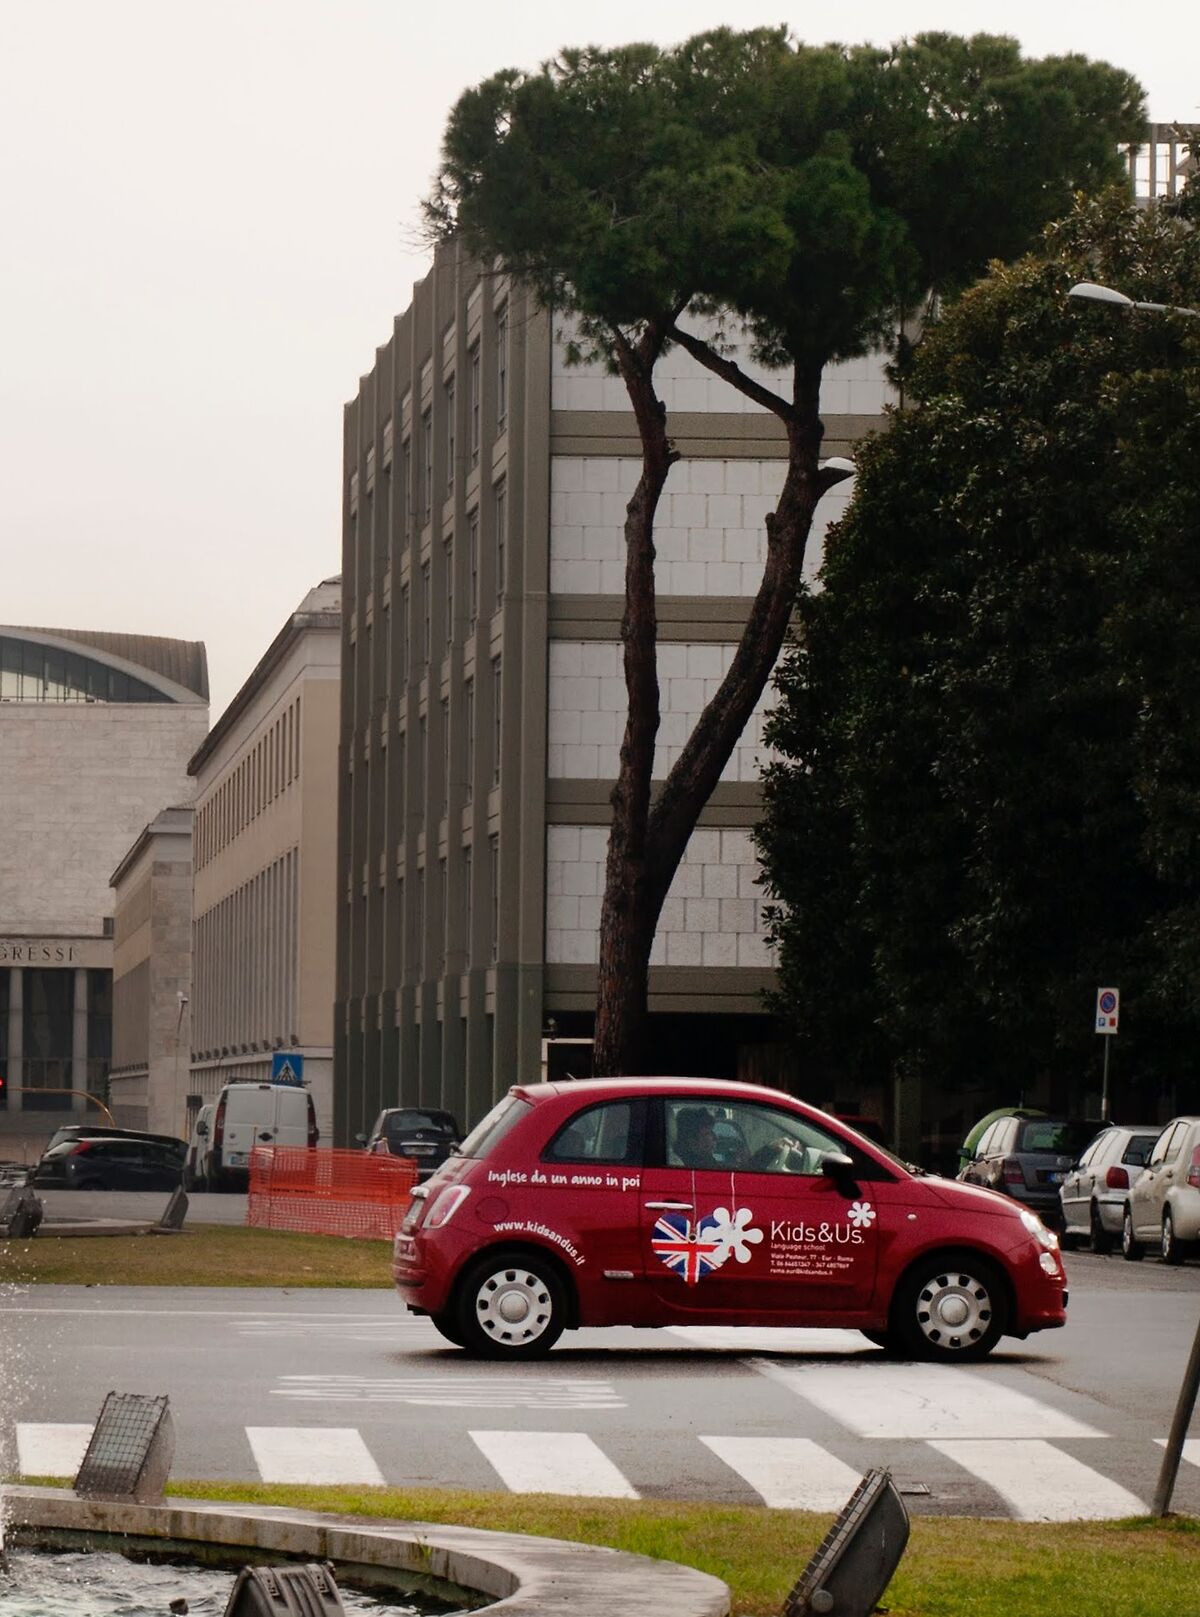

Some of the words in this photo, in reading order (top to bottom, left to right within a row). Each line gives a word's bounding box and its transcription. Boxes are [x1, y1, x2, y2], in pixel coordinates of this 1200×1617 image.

[487, 1169, 528, 1188] Inglese
[530, 1169, 547, 1185] da
[551, 1173, 568, 1185] un
[571, 1174, 603, 1186] anno
[606, 1173, 618, 1187] in
[622, 1174, 640, 1192] poi
[493, 1220, 587, 1267] www.kidsandus.it
